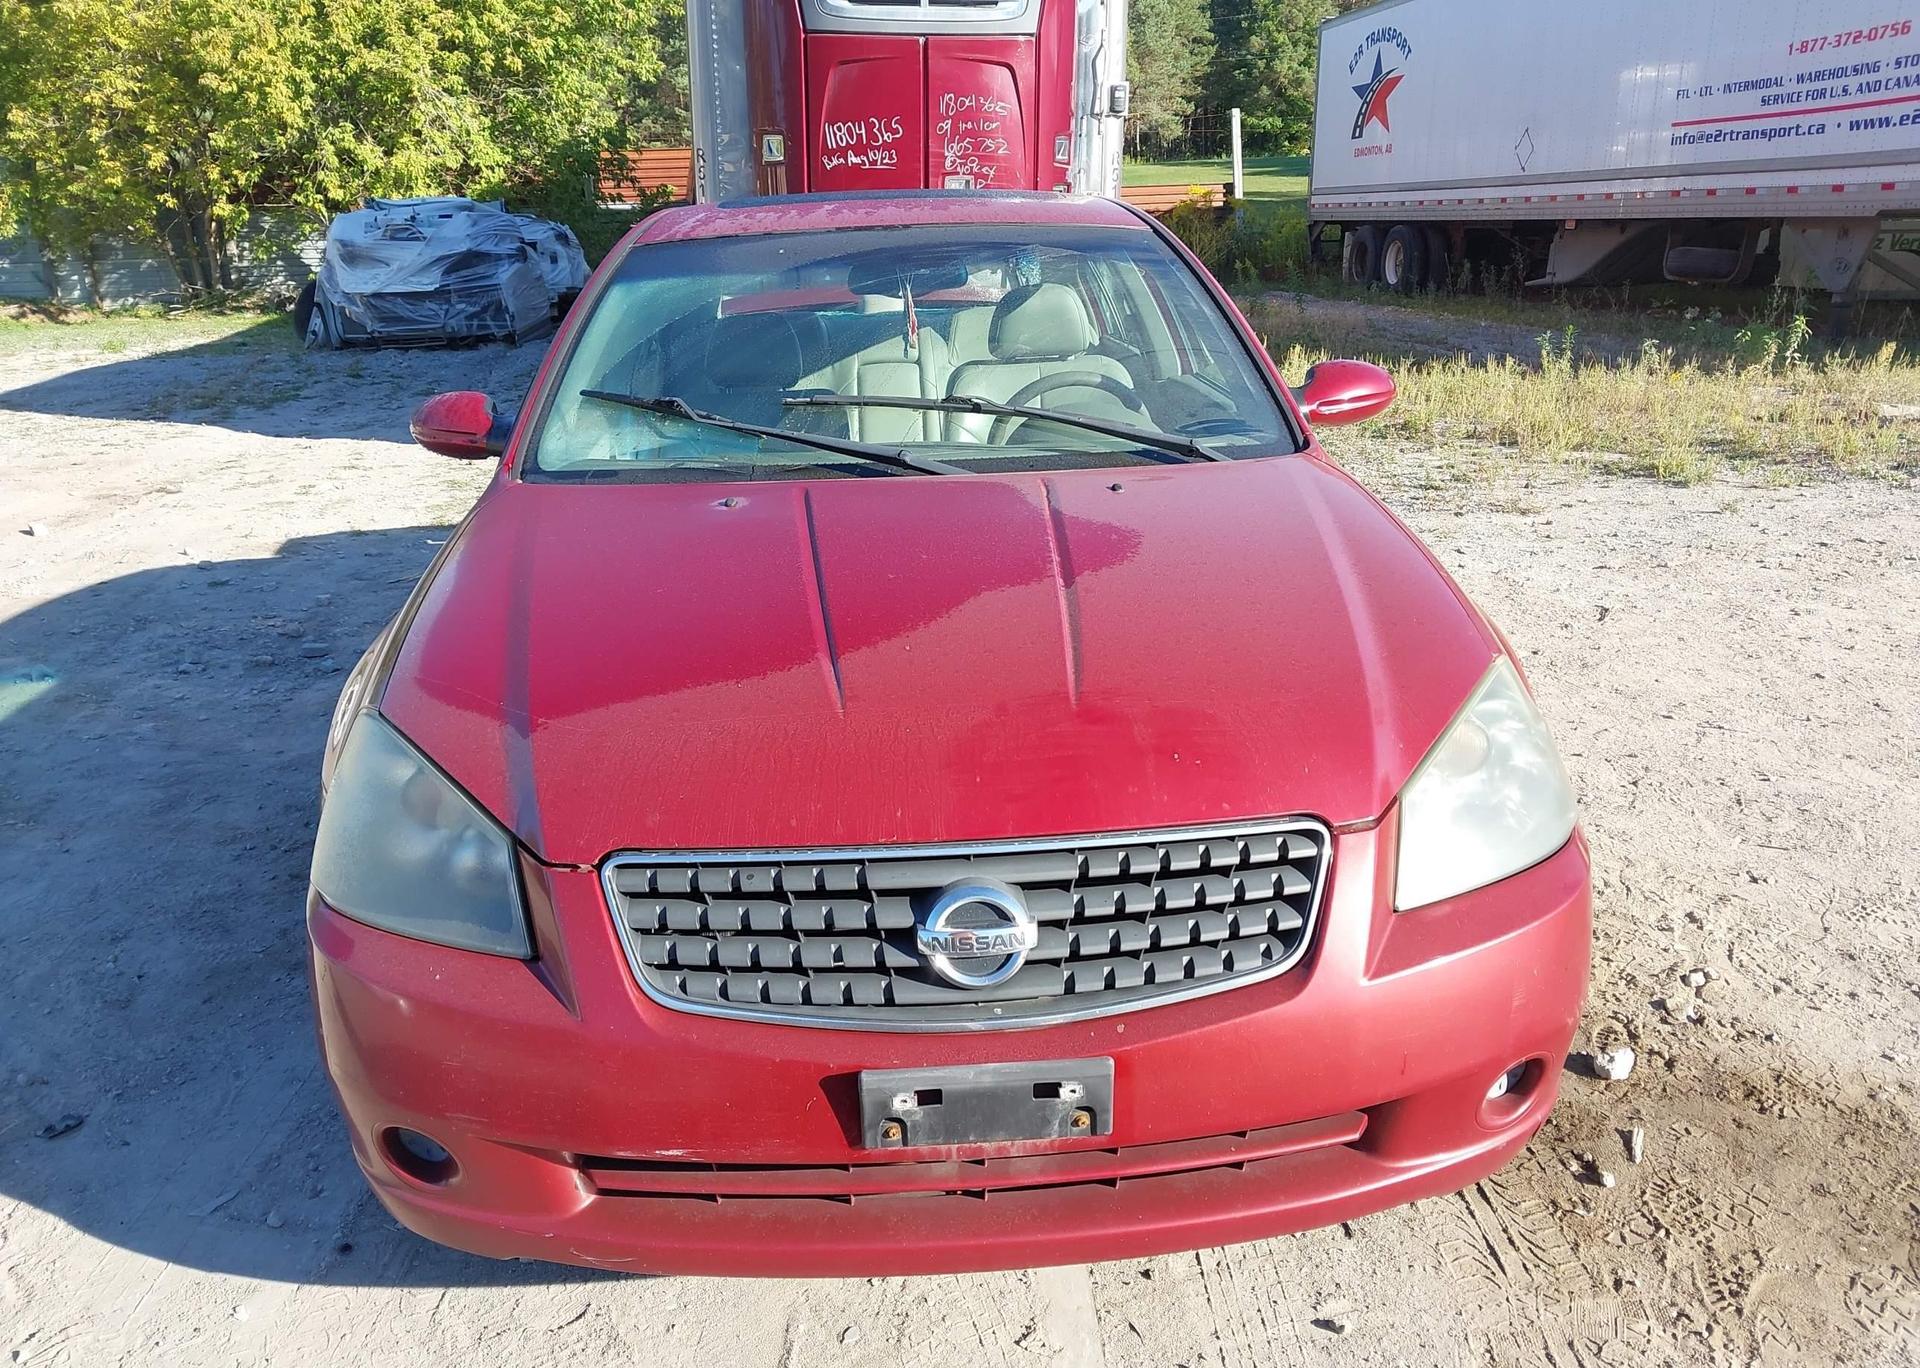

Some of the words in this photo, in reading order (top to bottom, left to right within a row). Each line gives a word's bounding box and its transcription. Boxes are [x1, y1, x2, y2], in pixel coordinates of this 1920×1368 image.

[1349, 43, 1364, 76] E2R
[1365, 26, 1412, 61] TRANSPORT
[1788, 20, 1912, 56] 1-877-372-0756
[1676, 88, 1690, 100] FTL
[1699, 85, 1714, 97] LTL
[1723, 76, 1785, 95] INTERMODAL
[1796, 60, 1881, 85] WAREHOUSING
[1760, 91, 1803, 107] SERVICE
[1805, 87, 1828, 102] FOR
[1830, 84, 1852, 98] U.S.
[1855, 80, 1882, 95] AND
[1670, 122, 1826, 146] info@e2rtransport.ca
[1385, 143, 1393, 154] AB
[931, 931, 1026, 952] NISSAN
